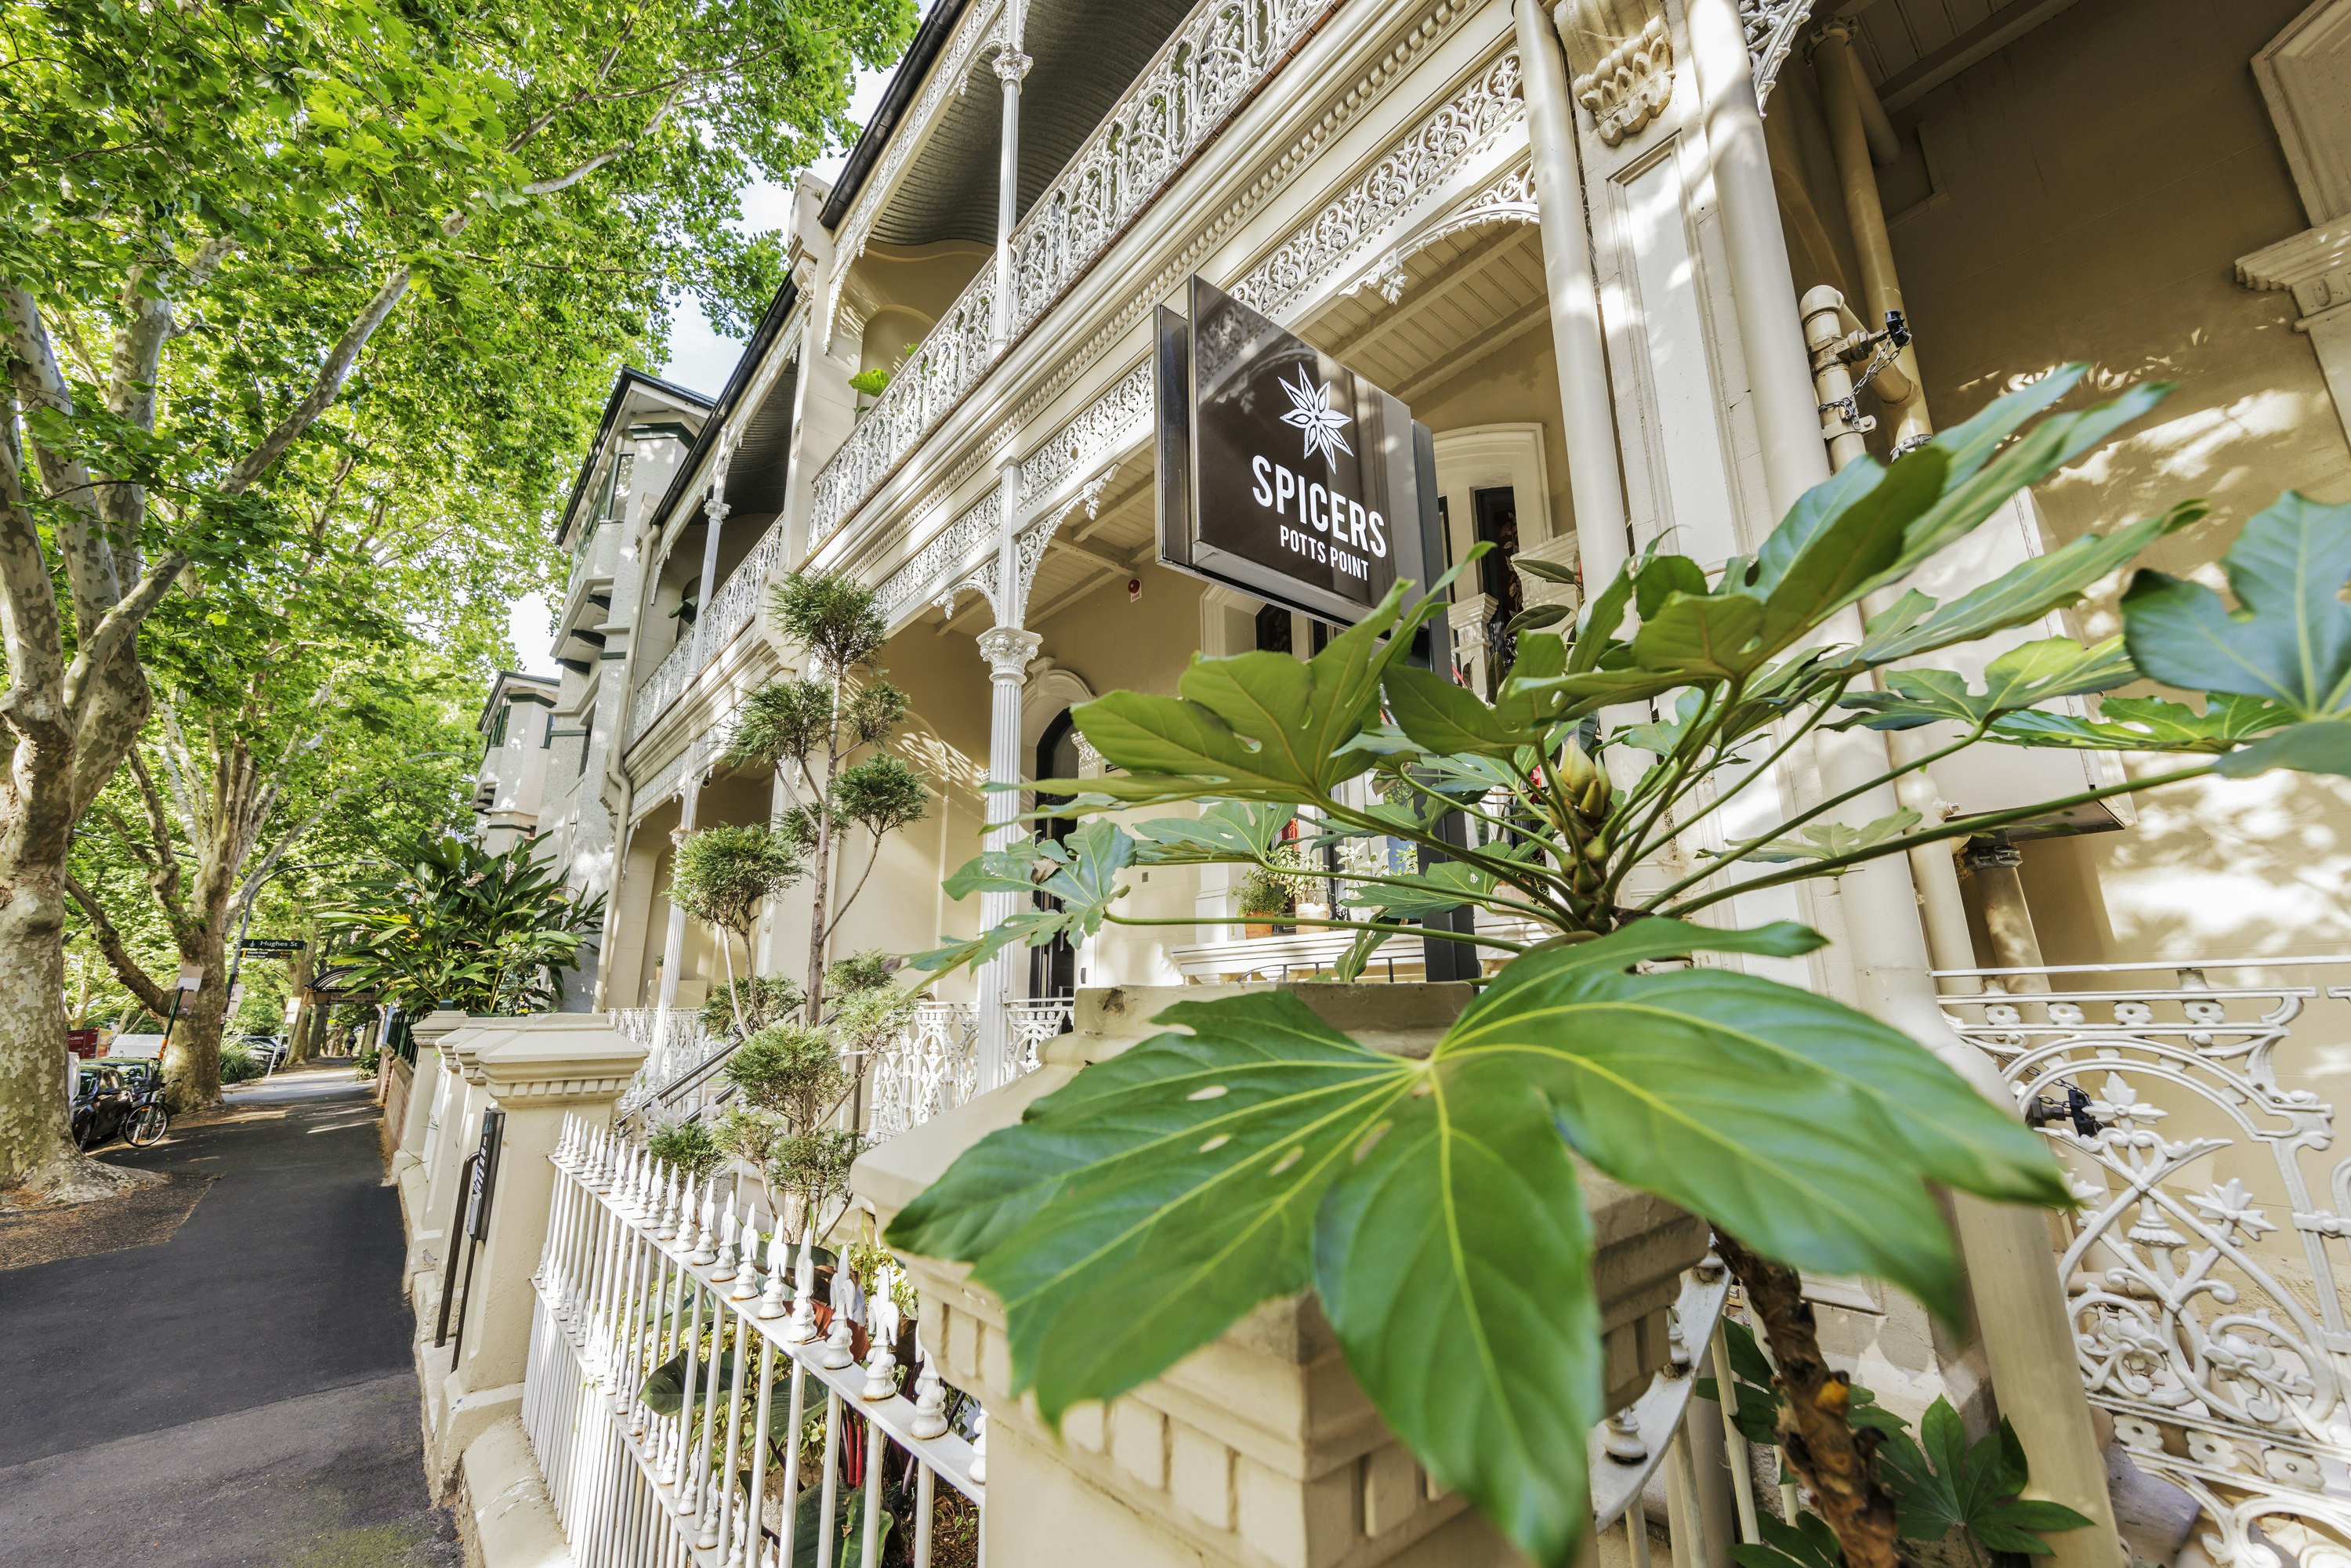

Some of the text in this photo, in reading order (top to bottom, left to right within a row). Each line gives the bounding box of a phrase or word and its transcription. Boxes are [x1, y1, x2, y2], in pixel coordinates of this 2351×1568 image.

[1252, 454, 1386, 558] SPICERS
[1280, 524, 1368, 581] POTTS POINT
